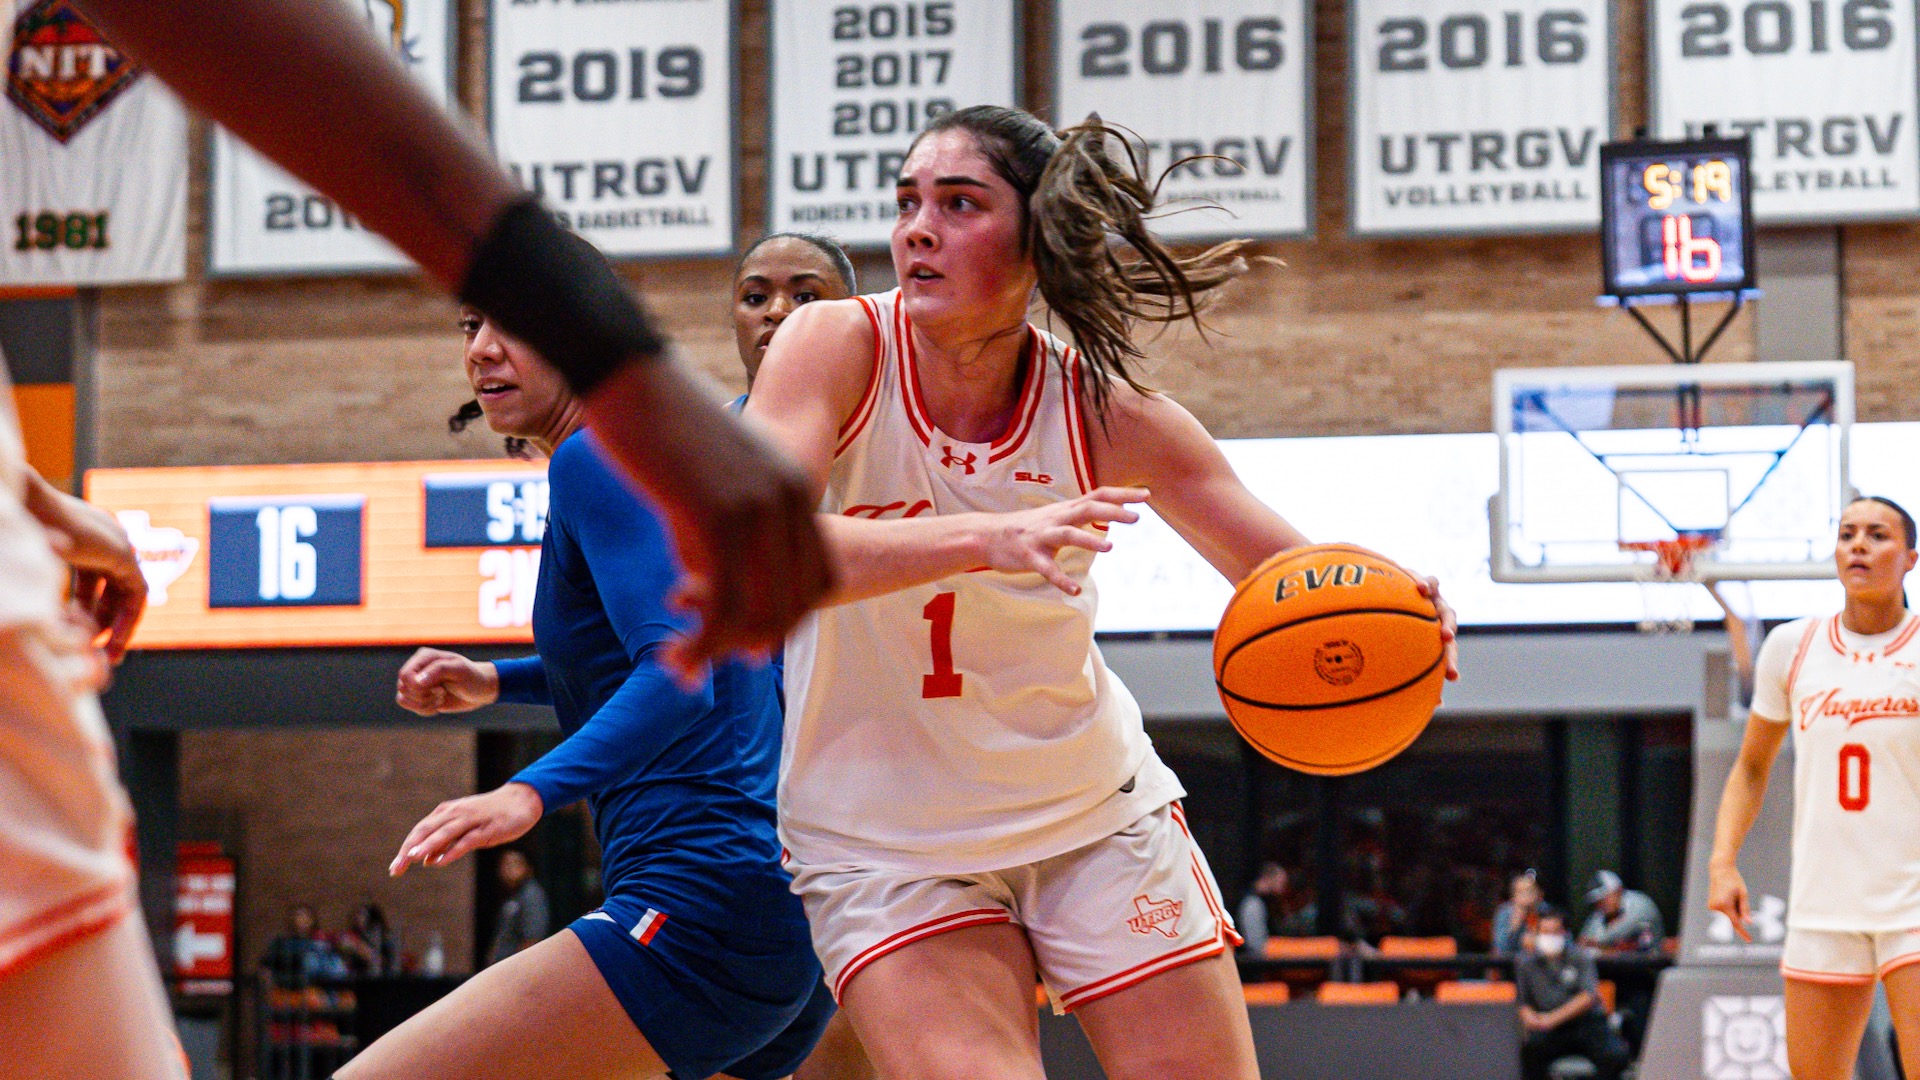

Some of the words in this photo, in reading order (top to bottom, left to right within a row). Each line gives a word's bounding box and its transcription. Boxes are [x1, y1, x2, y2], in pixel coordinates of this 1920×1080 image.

[832, 4, 956, 40] 2015
[1378, 10, 1590, 72] 2016
[1680, 0, 1894, 57] 2016
[20, 44, 117, 80] NIT
[834, 50, 954, 88] 2017
[1079, 17, 1286, 77] 2016
[517, 46, 704, 102] 2019
[790, 151, 903, 192] UTR
[1131, 136, 1292, 180] TRGV
[1379, 126, 1596, 174] UTRGV
[1384, 181, 1588, 206] VOLLEYBALL
[1644, 161, 1732, 209] 5:19
[15, 211, 110, 250] 1981
[264, 192, 356, 231] 20
[1663, 213, 1722, 283] 16
[257, 505, 318, 602] 16
[922, 591, 963, 699] 1
[1838, 742, 1871, 812] 0
[1127, 900, 1183, 934] UTRGV
